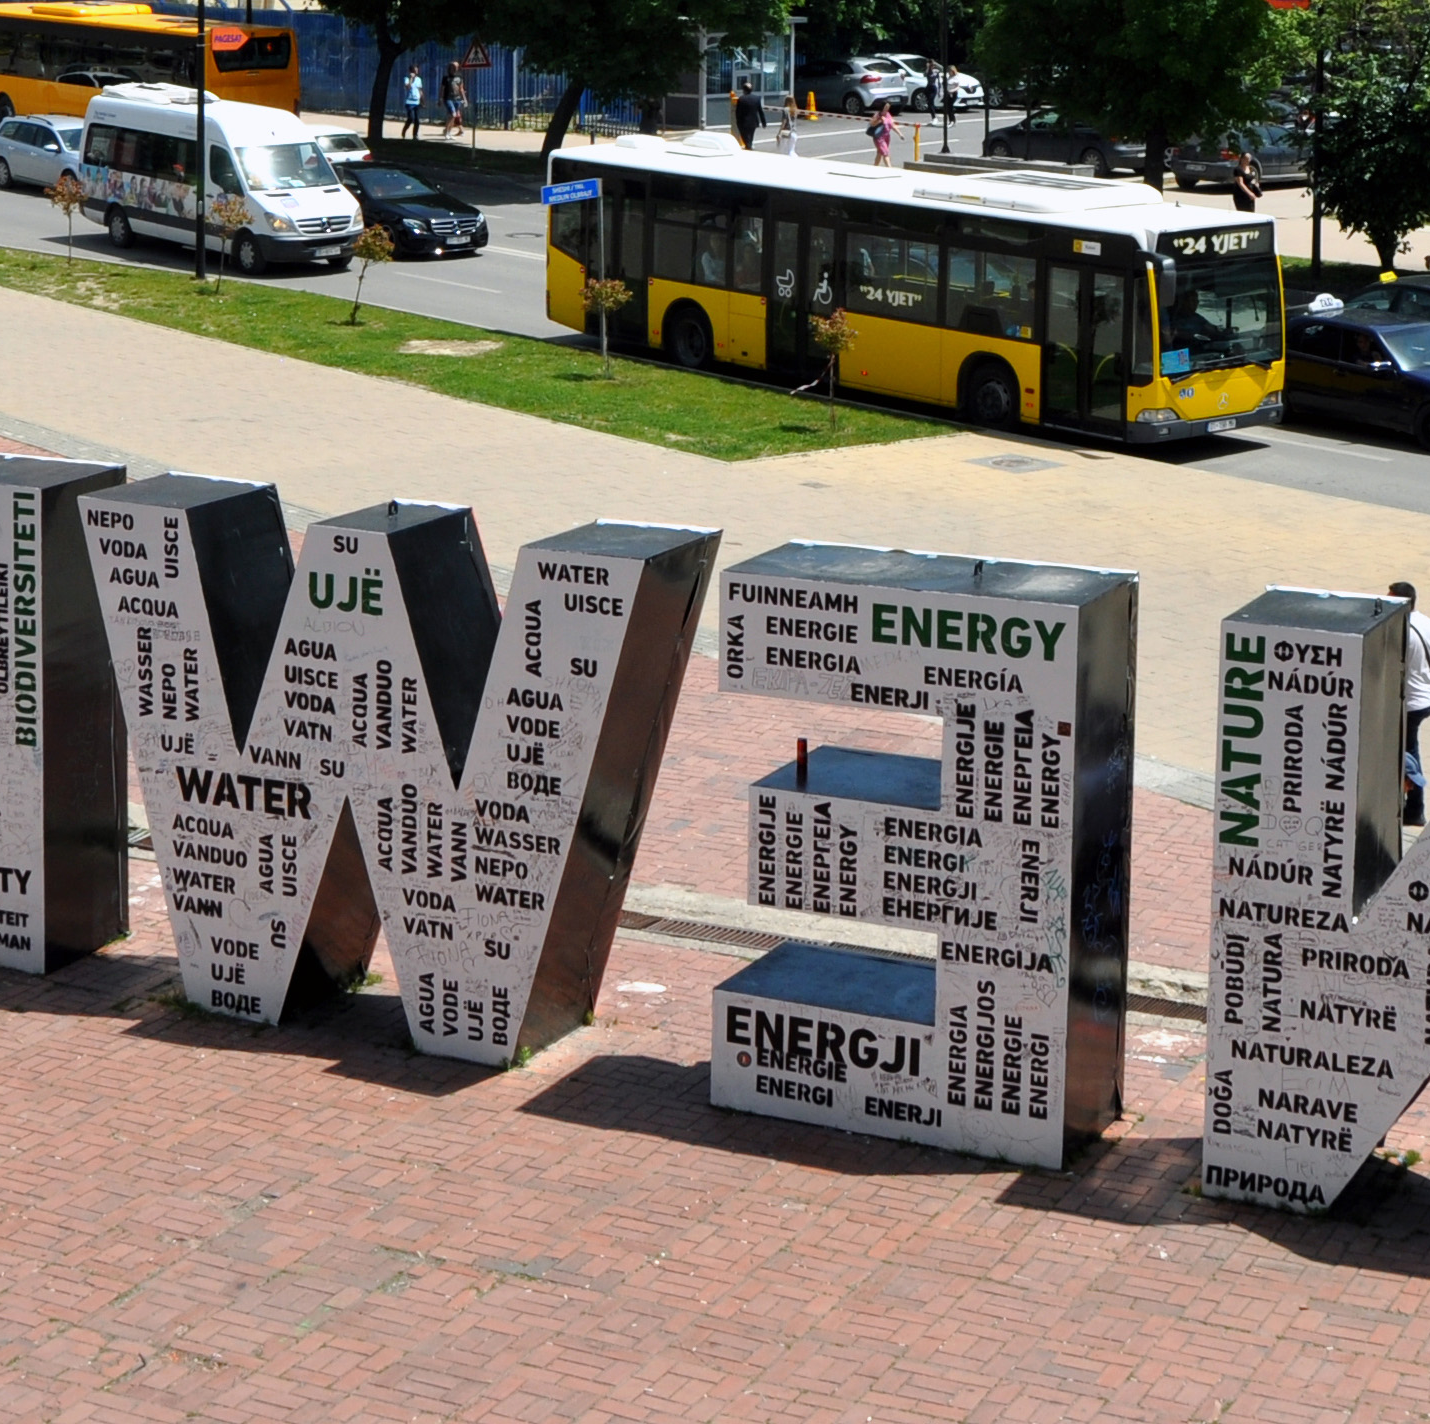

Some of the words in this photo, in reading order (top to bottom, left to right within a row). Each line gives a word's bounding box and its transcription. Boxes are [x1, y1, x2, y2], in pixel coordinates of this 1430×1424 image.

[87, 509, 134, 531] NEPO
[99, 538, 147, 560] VODA
[164, 516, 179, 578] UISCE
[333, 535, 358, 554] SU
[109, 567, 159, 588] AGUA
[309, 568, 383, 615] UJË
[118, 596, 179, 618] ACQUA
[728, 582, 858, 614] FUINNEAMH
[13, 492, 38, 747] BIODIVERSITETI
[766, 616, 858, 644] ENERGIE
[872, 603, 1066, 662] ENERGY
[284, 638, 337, 661] AGUA
[726, 614, 745, 679] ORKA
[766, 646, 861, 675] ENERGIA
[137, 627, 154, 717] WASSER
[285, 665, 338, 689] UISCE
[570, 657, 597, 678] SU
[924, 666, 1023, 693] ENERGÍA
[1267, 668, 1354, 699] NÁDÚR
[162, 663, 177, 720] NEPO
[184, 647, 200, 722] WATER
[850, 683, 929, 710] ENERJI
[284, 691, 336, 715] VODA
[352, 673, 368, 748] ACQUA
[376, 660, 392, 750] VANDUO
[284, 719, 332, 742] VATN
[506, 715, 560, 739] VODE
[1219, 632, 1266, 847] NATURE
[160, 733, 195, 755] UJË
[249, 745, 301, 770] VANN
[1283, 704, 1304, 814] PRIRODA
[319, 758, 345, 778] SU
[956, 703, 976, 819] ENERGIJE
[175, 765, 312, 820] WATER
[1041, 733, 1061, 828] ENERGY
[172, 814, 234, 840] ACQUA
[475, 799, 530, 824] VODA
[401, 783, 418, 875] VANDUO
[475, 827, 561, 855] WASSER
[884, 817, 982, 848] ENERGIA
[172, 840, 247, 868] VANDUO
[259, 834, 274, 894] AGUA
[282, 834, 297, 897] UISCE
[451, 821, 467, 882] VANN
[758, 794, 777, 906] ENERGIJE
[884, 845, 965, 873] ENERGI
[172, 868, 235, 894] WATER
[475, 856, 528, 880] NEPO
[839, 824, 858, 917] ENERGY
[1019, 839, 1040, 924] ENERJI
[1229, 853, 1313, 886] NÁDÚR
[883, 871, 977, 901] ENERGJI
[172, 894, 222, 918] VANN
[1219, 898, 1349, 933] NATUREZA
[403, 916, 453, 941] VATN
[211, 936, 259, 960] VODE
[941, 941, 1053, 974] ENERGIJA
[211, 962, 245, 985] UJË
[1262, 932, 1283, 1033] NATURA
[443, 978, 459, 1037] VODE
[1300, 999, 1397, 1032] NATYRË
[726, 1005, 921, 1077] ENERGJI
[947, 1004, 968, 1107] ENERGIA
[974, 980, 995, 1111] ENERGIJOS
[757, 1048, 847, 1083] ENERGIE
[1001, 1014, 1023, 1116] ENERGIE
[1231, 1039, 1394, 1079] NATURALEZA
[756, 1075, 833, 1108] ENERGI
[1028, 1032, 1050, 1120] ENERGI
[865, 1096, 942, 1128] ENERJI
[1258, 1088, 1358, 1124] NARAVE
[1205, 1164, 1326, 1205] ПРИРОДА
